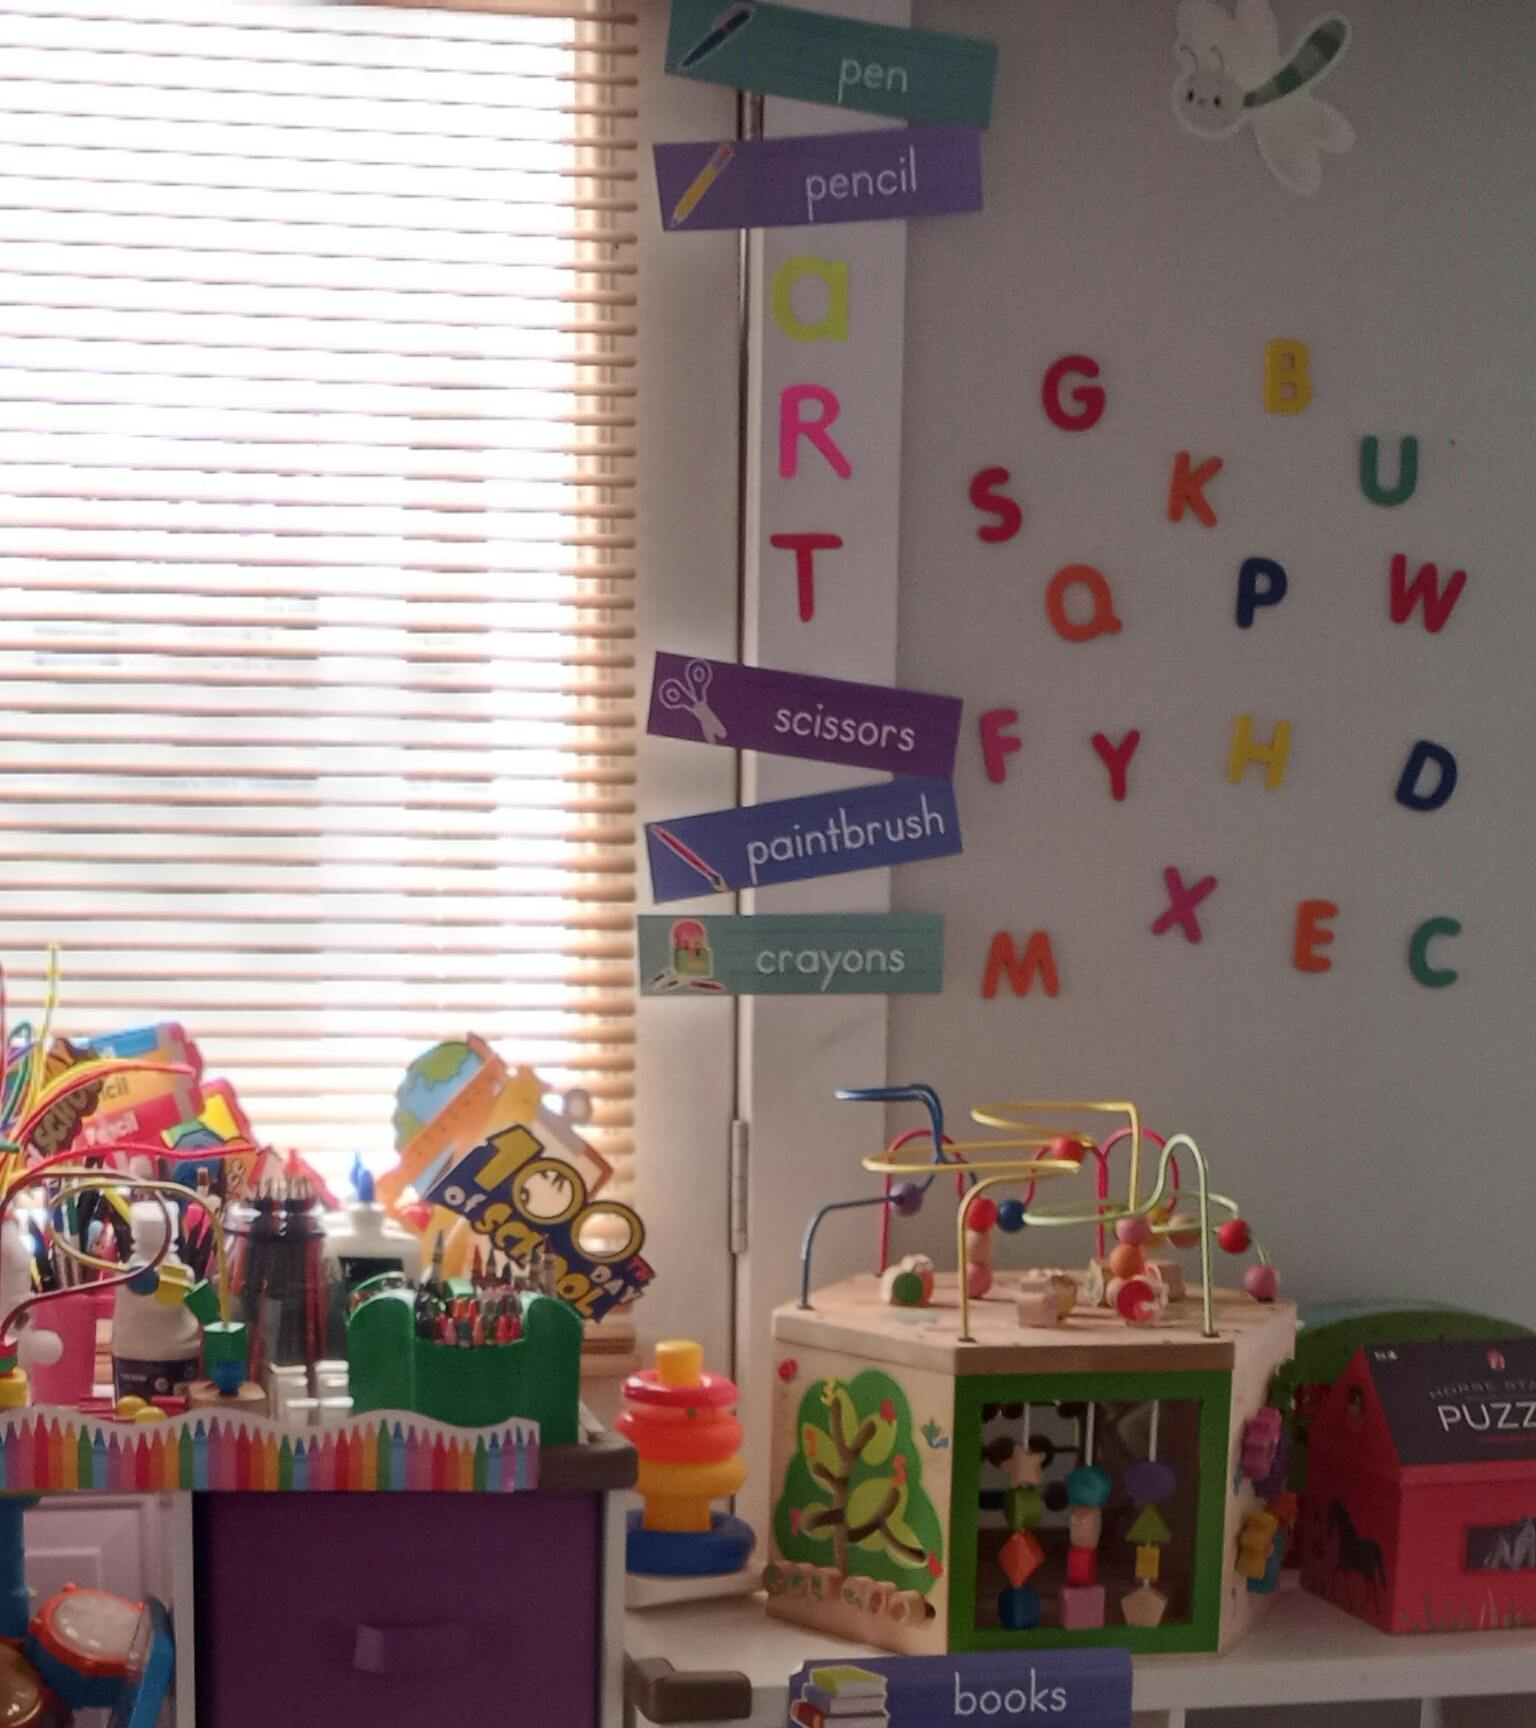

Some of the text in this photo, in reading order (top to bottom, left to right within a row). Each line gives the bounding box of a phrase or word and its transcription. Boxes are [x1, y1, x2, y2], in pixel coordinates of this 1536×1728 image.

[838, 57, 908, 104] pen
[805, 145, 917, 221] pencil
[1042, 355, 1106, 431] G
[1264, 340, 1312, 413] B
[969, 467, 1022, 543] S
[1167, 452, 1223, 527] K
[1359, 435, 1417, 507] U
[1045, 564, 1122, 643] Q
[1235, 557, 1288, 628] P
[1390, 554, 1467, 633] W
[774, 704, 915, 751] scissors
[979, 708, 1022, 784] F
[1227, 715, 1292, 789] H
[1091, 730, 1140, 800] Y
[1395, 740, 1457, 812] D
[745, 796, 946, 884] paintbrush
[1151, 867, 1217, 944] X
[1293, 900, 1338, 973] E
[755, 944, 906, 990] crayons
[982, 931, 1059, 1000] M
[1408, 917, 1462, 987] C
[954, 1667, 1066, 1716] books
